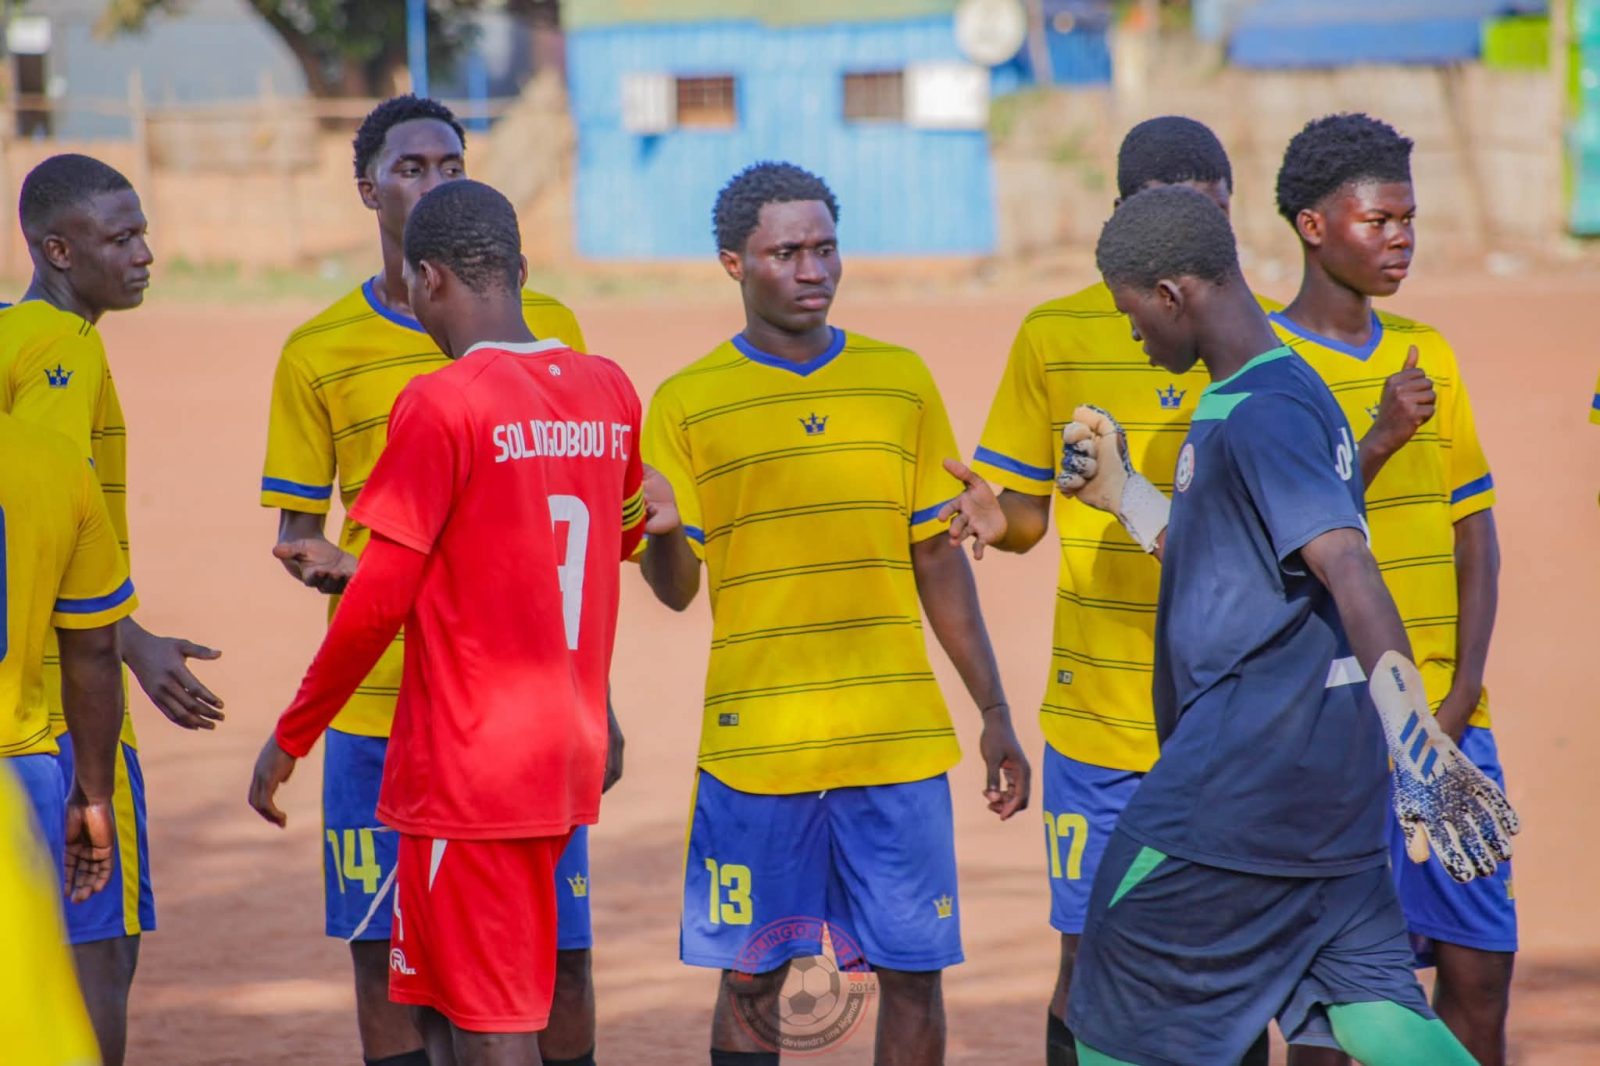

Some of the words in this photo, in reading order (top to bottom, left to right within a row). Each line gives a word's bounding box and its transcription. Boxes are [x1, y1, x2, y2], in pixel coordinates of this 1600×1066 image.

[611, 423, 631, 461] FC
[327, 829, 381, 894] 14
[1043, 811, 1088, 880] 17
[705, 858, 753, 925] 13
